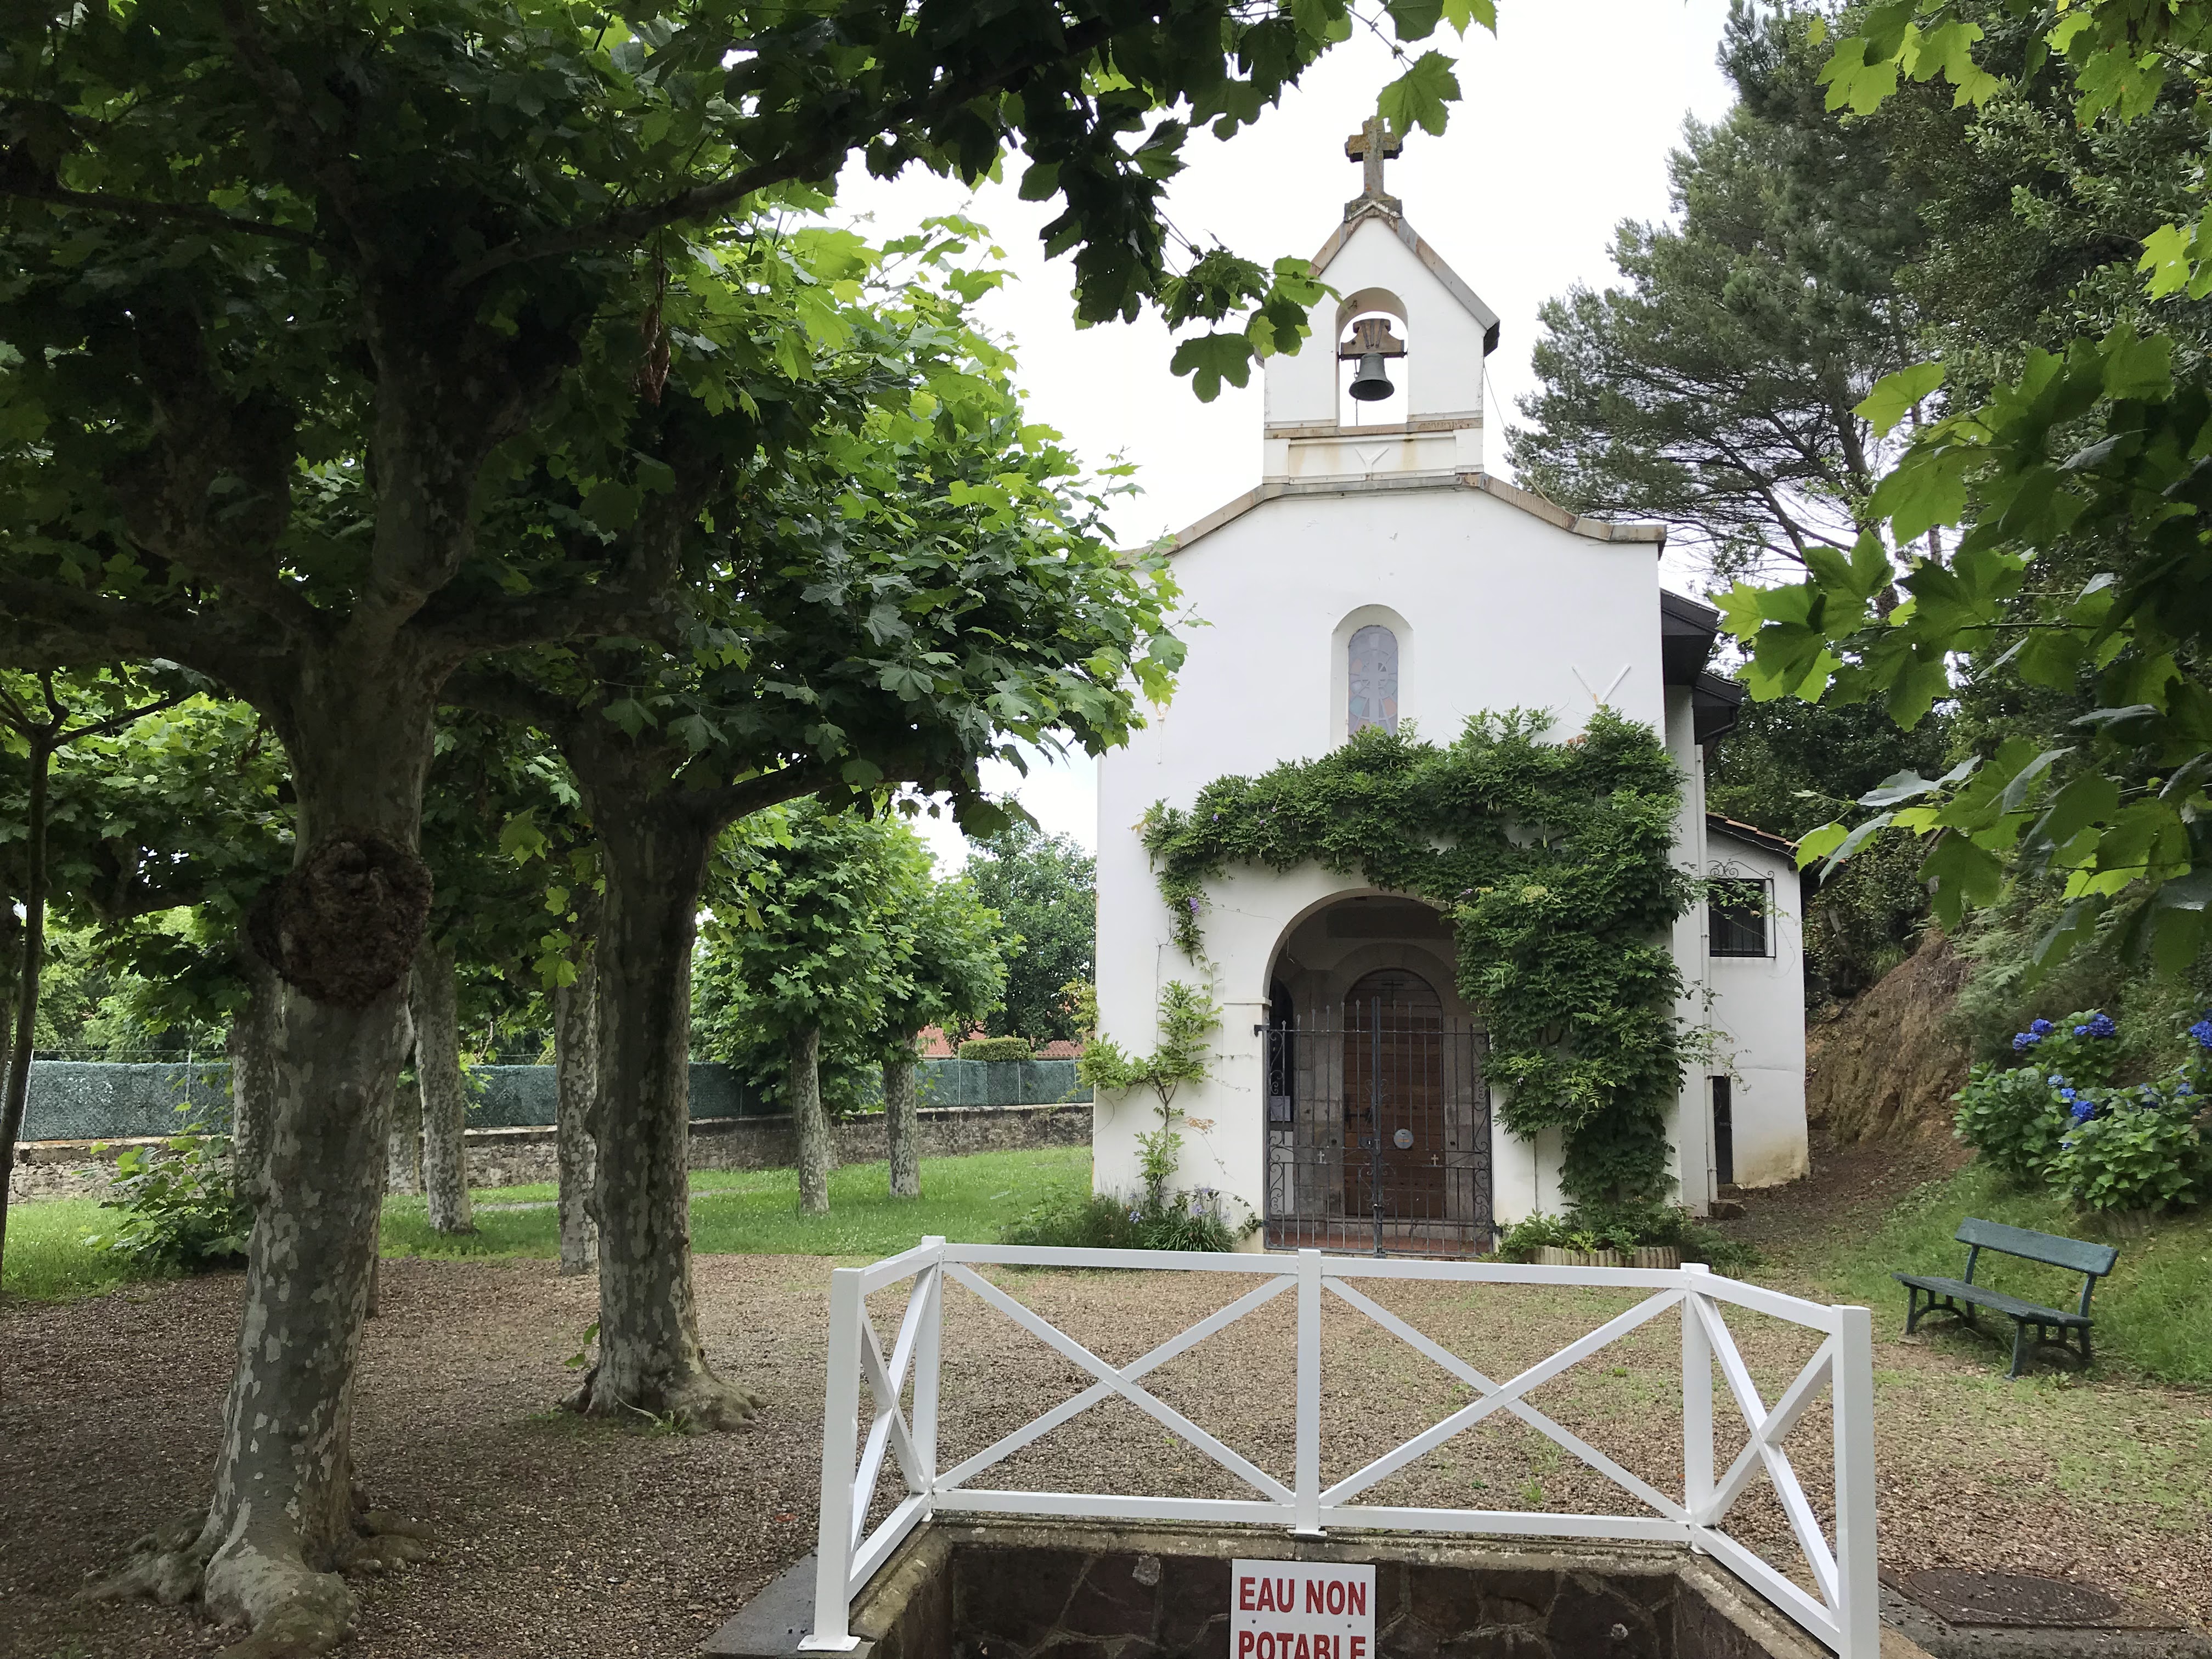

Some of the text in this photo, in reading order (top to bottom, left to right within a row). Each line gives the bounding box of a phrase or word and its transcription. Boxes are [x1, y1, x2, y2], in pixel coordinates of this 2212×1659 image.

[1240, 1577, 1366, 1616] EAU NON
[1238, 1630, 1366, 1659] POTABLE
